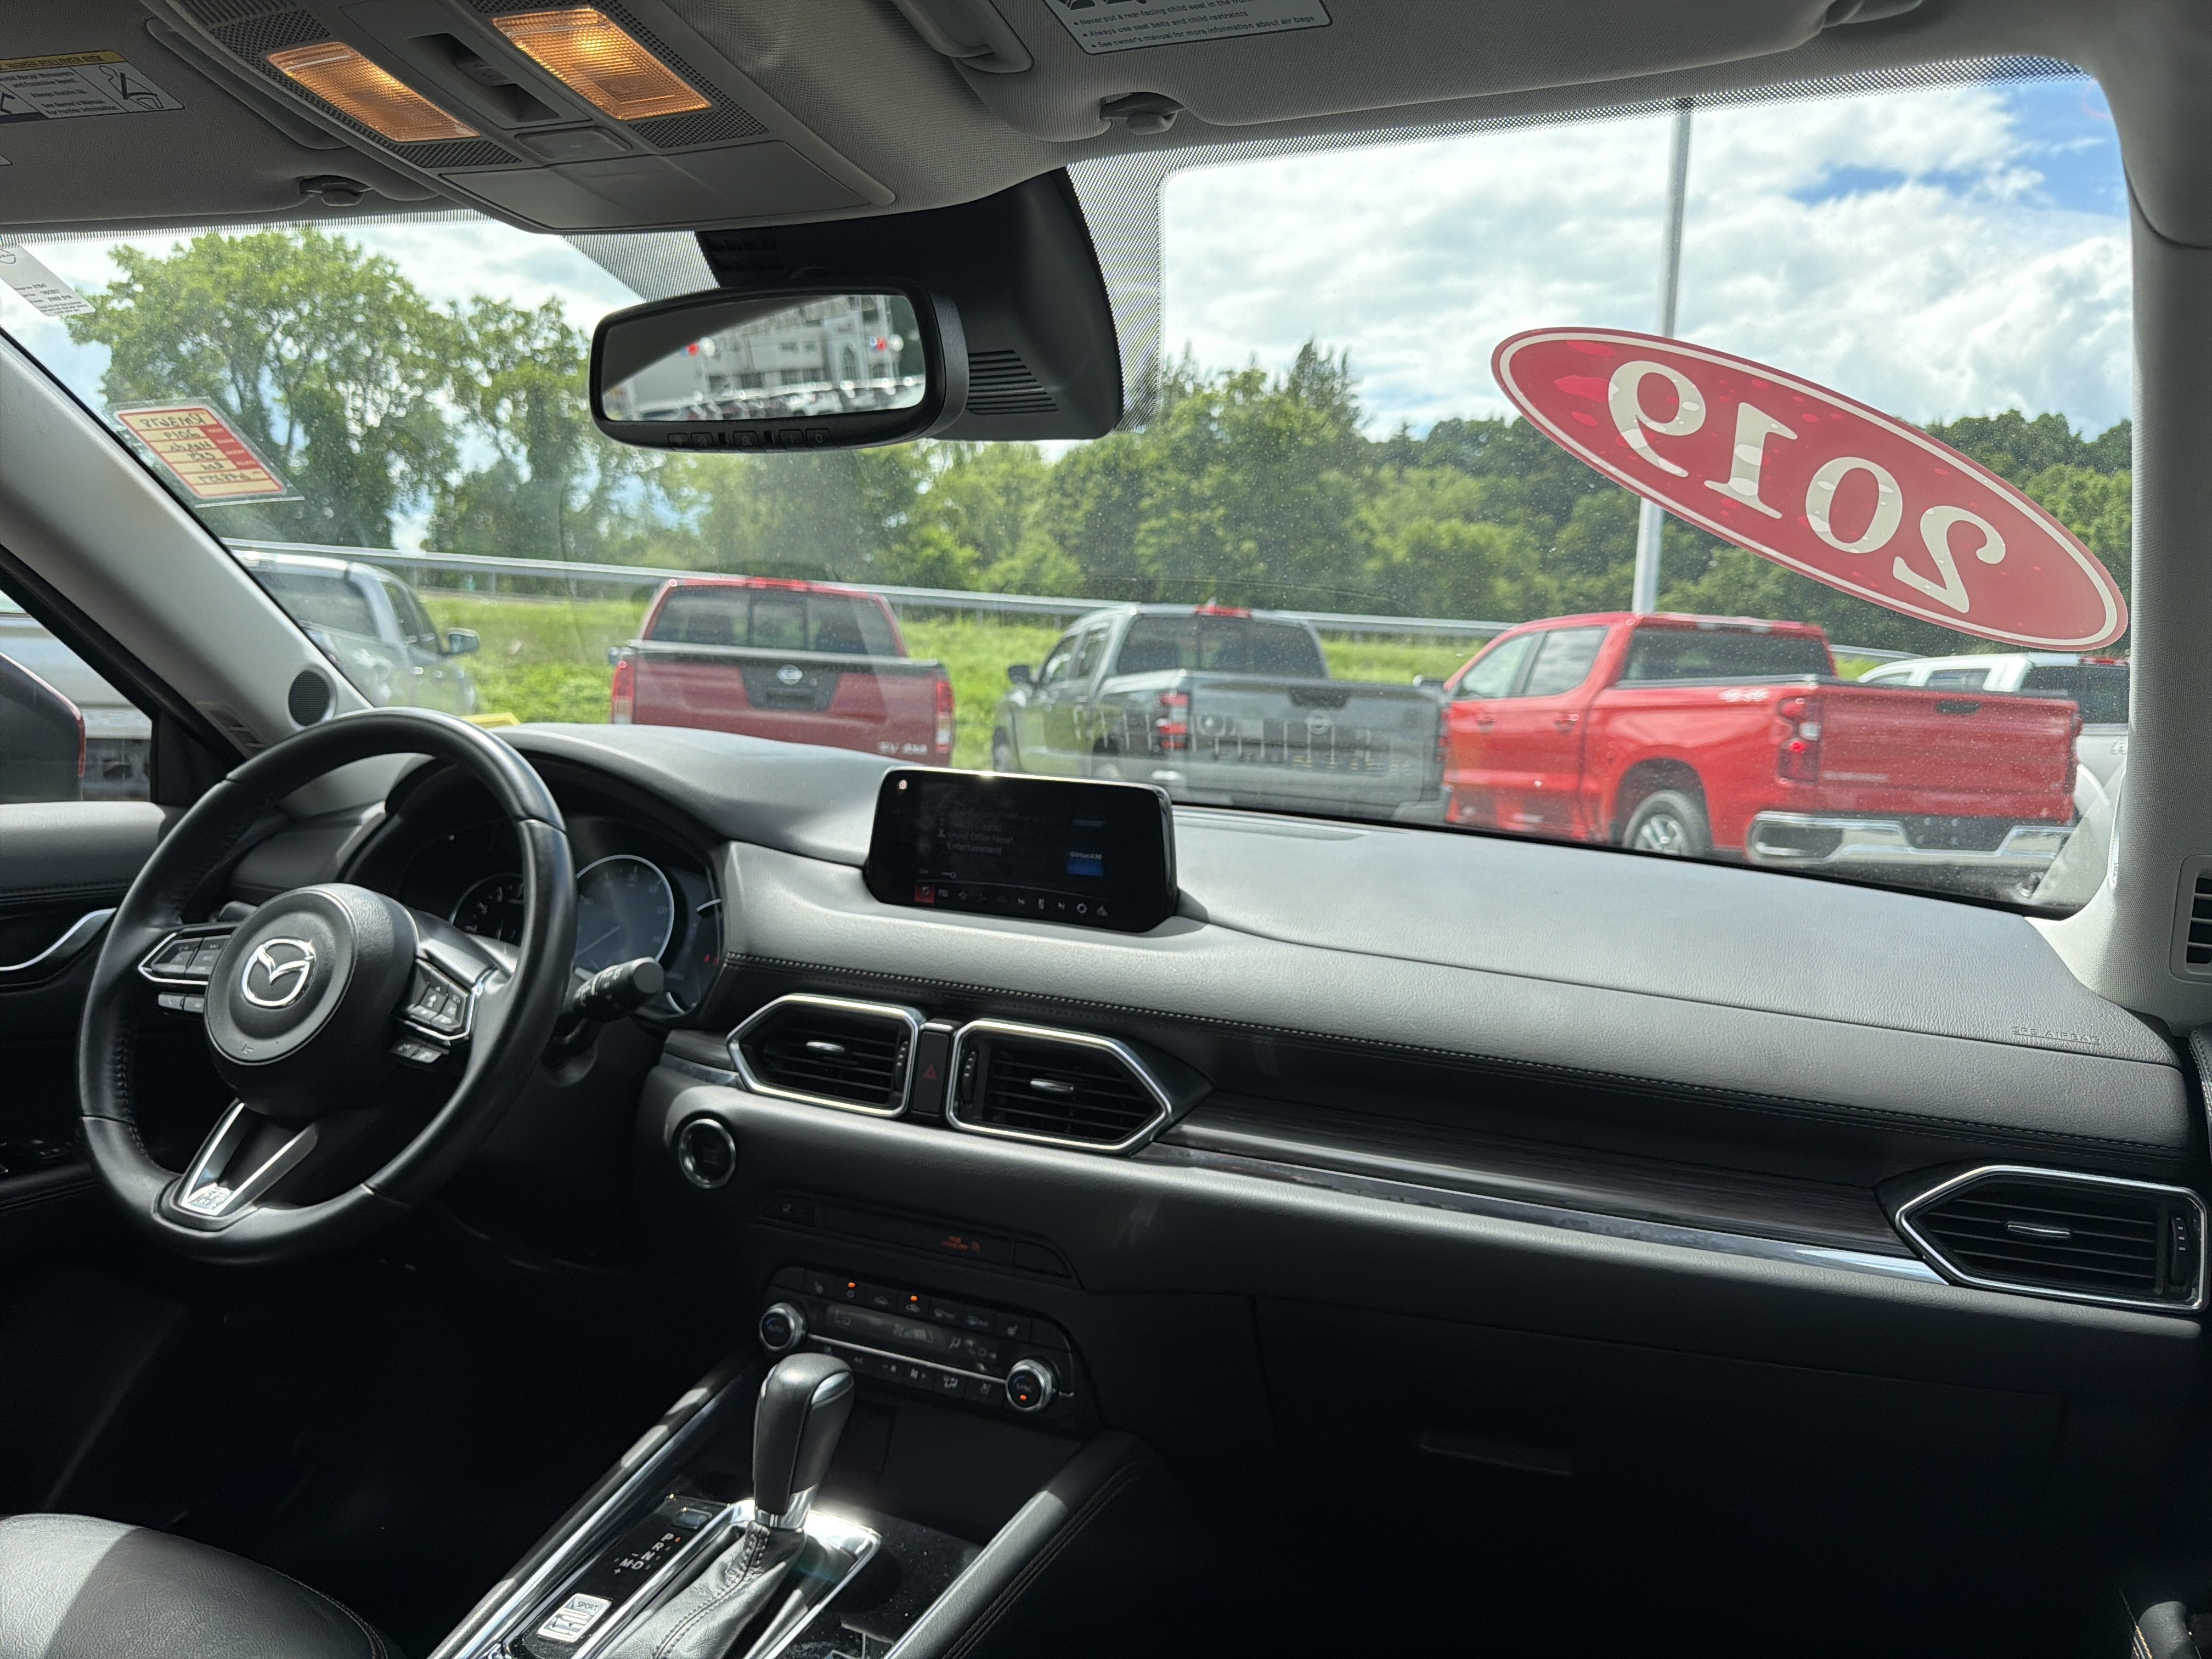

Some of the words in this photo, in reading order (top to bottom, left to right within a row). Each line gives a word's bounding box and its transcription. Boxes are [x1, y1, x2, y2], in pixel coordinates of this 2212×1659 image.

[1080, 17, 1102, 25] Never
[1125, 8, 1167, 19] rear-facing
[1167, 4, 1187, 13] child
[1189, 2, 1206, 10] seat
[1090, 27, 1117, 37] Always
[1152, 20, 1170, 29] belts
[1188, 15, 1208, 24] child
[1210, 11, 1249, 21] restraints
[1114, 36, 1143, 46] owner's
[1144, 32, 1172, 42] manual
[1208, 23, 1254, 33] information
[1256, 20, 1280, 29] about
[1294, 15, 1315, 24] bags
[661, 1533, 674, 1542] P
[651, 1542, 664, 1551] R
[641, 1551, 656, 1561] N
[619, 1558, 634, 1567] M
[631, 1561, 644, 1570] D
[578, 1600, 599, 1611] SPORT
